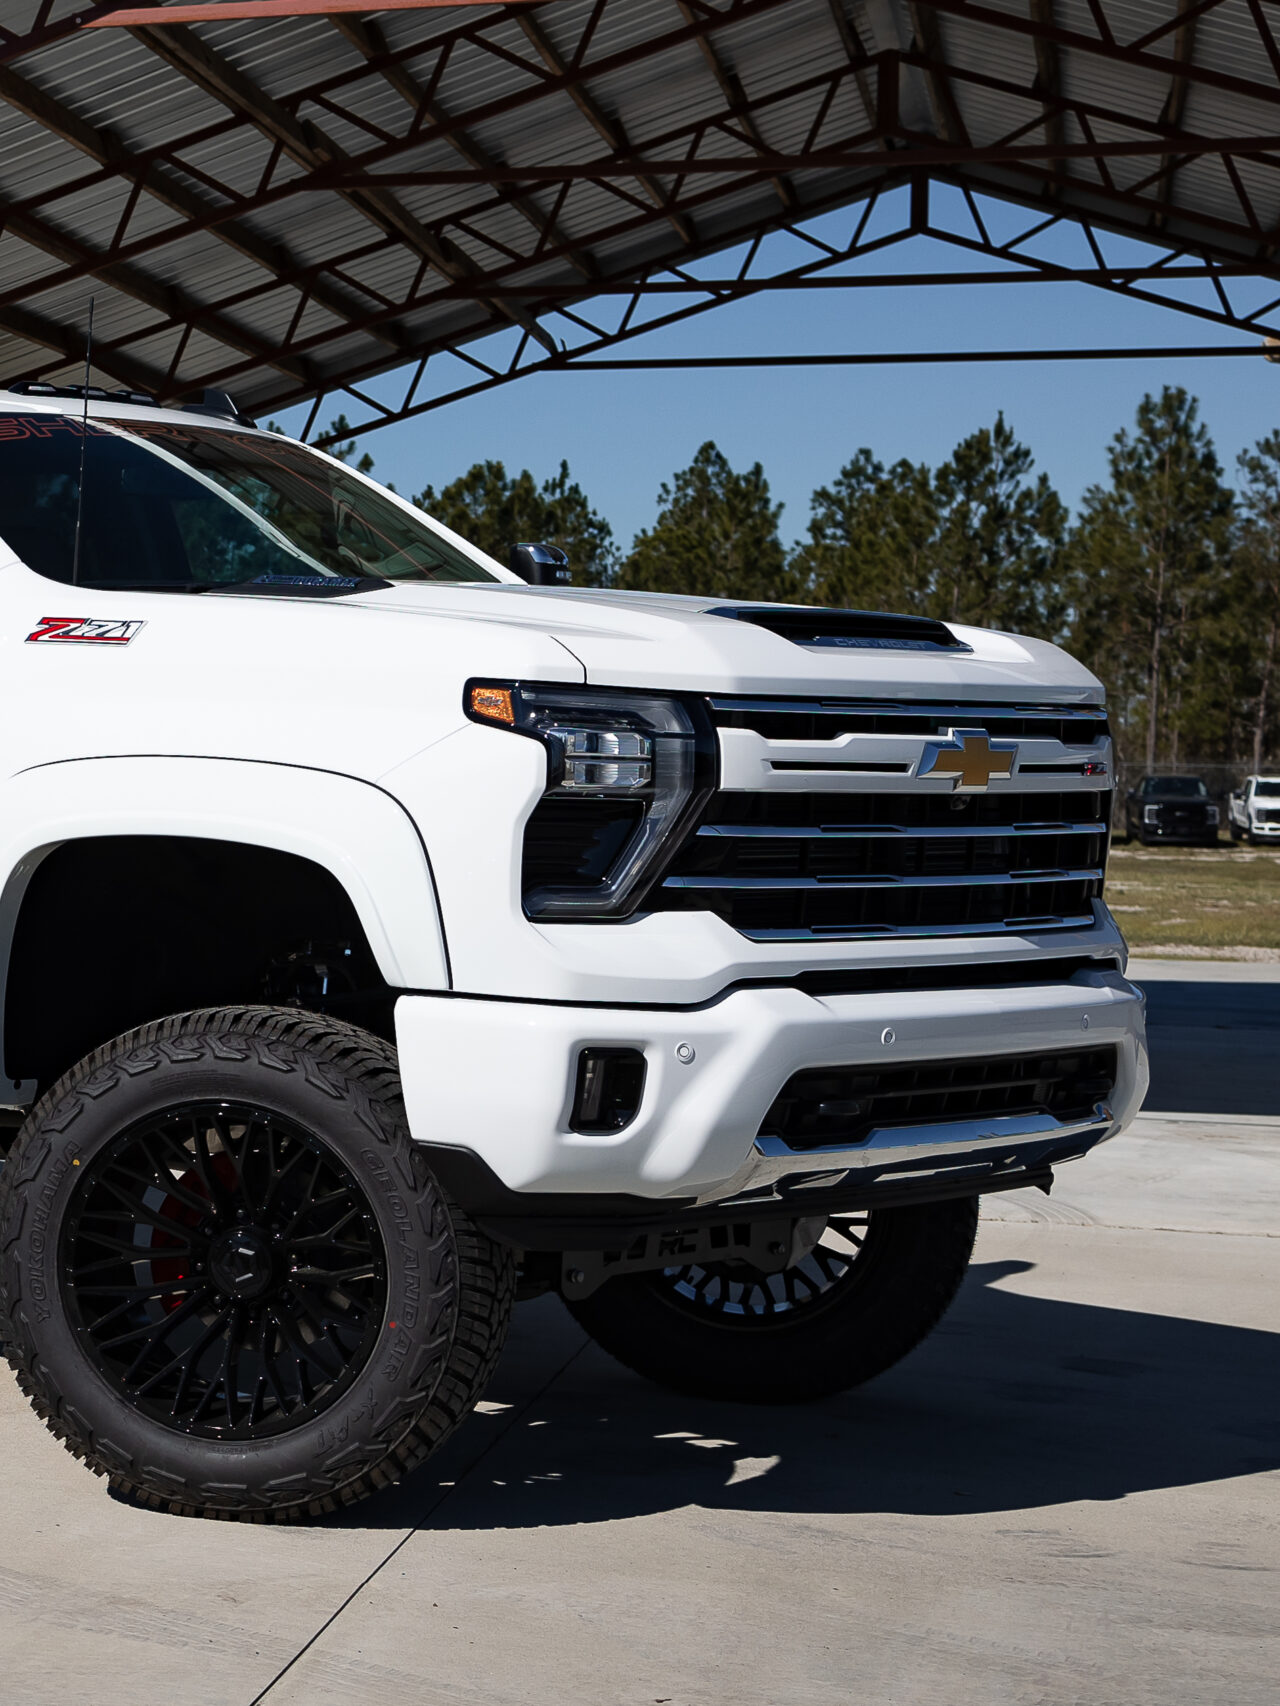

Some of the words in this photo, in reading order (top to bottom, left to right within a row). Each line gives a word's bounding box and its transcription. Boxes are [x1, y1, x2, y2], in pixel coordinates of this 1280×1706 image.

[24, 616, 146, 647] Z71
[28, 1140, 81, 1324] YOKOHAMA
[361, 1149, 422, 1383] GEOLANDAR
